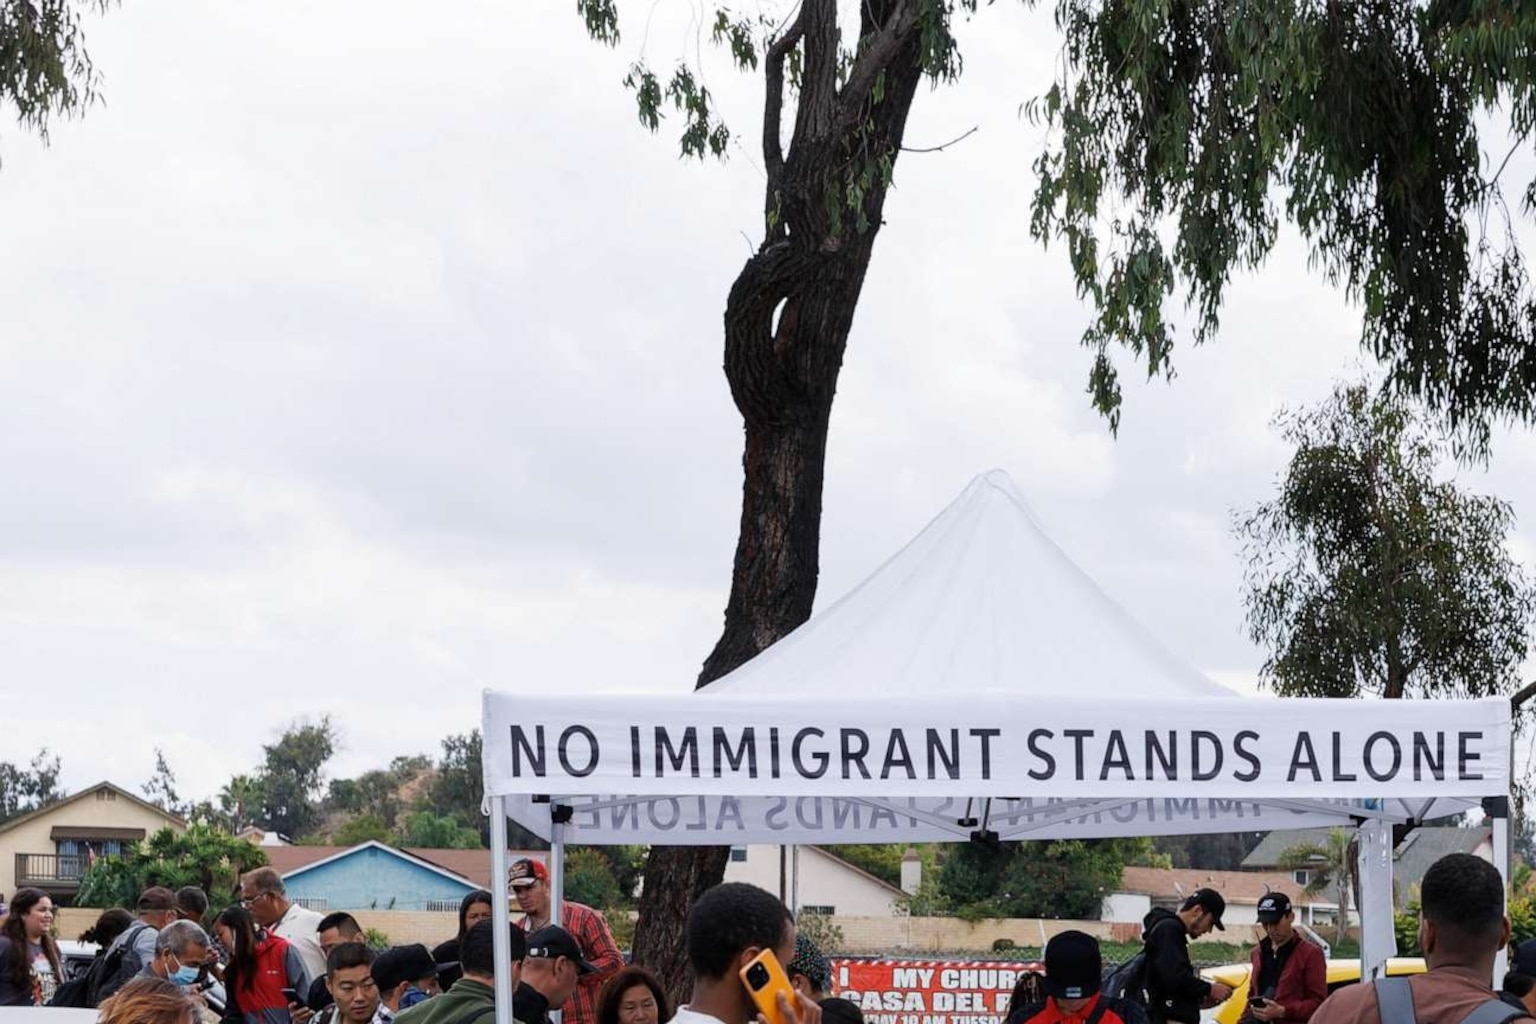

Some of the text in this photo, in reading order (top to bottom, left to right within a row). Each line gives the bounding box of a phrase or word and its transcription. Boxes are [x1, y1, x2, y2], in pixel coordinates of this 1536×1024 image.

[510, 724, 1483, 782] NO IMMIGRANT STANDS ALONE
[840, 967, 1046, 989] I MY CHUR
[840, 990, 926, 1012] CASA
[932, 992, 988, 1012] DEL
